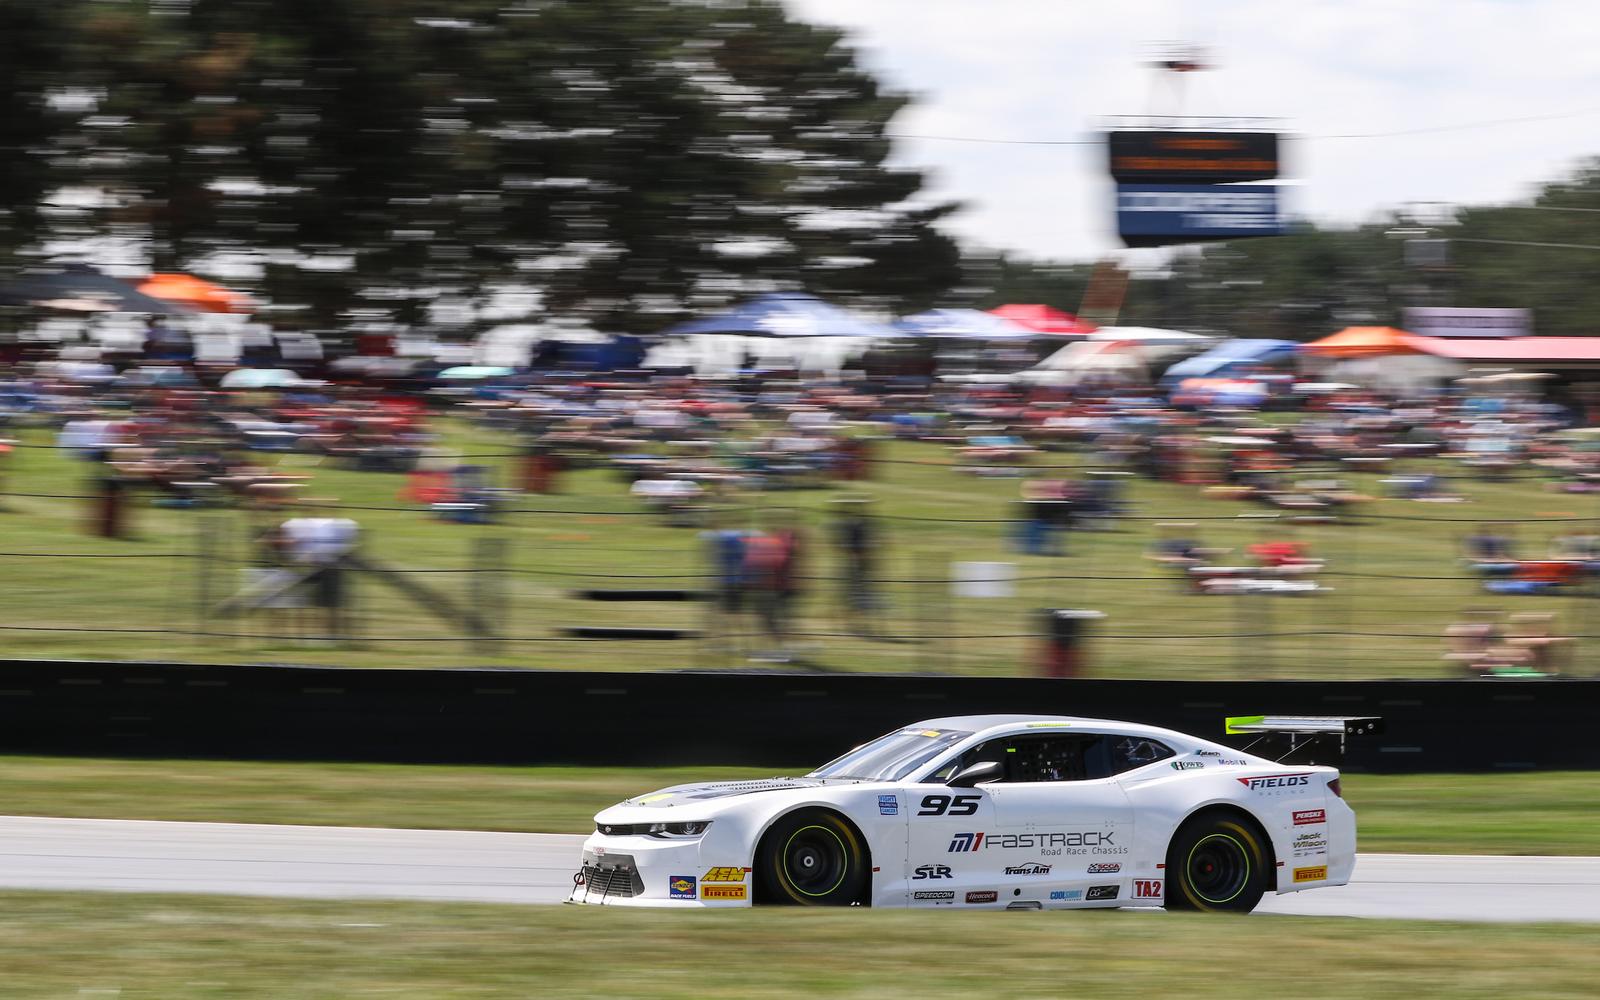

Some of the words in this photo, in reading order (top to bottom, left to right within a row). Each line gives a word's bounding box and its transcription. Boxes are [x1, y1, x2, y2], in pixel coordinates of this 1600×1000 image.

[1250, 776, 1309, 790] FIELDS
[917, 795, 983, 816] 95
[1293, 840, 1327, 848] Wilson
[1040, 848, 1062, 856] Road
[1066, 847, 1088, 855] Race
[1091, 846, 1129, 855] Chassis
[700, 867, 746, 882] AEM
[912, 867, 953, 879] SLR
[1005, 867, 1031, 875] Trans
[1032, 866, 1050, 874] Am
[1296, 868, 1325, 880] PIRELLI
[704, 887, 744, 897] PIRELLI
[1135, 881, 1162, 897] TA2
